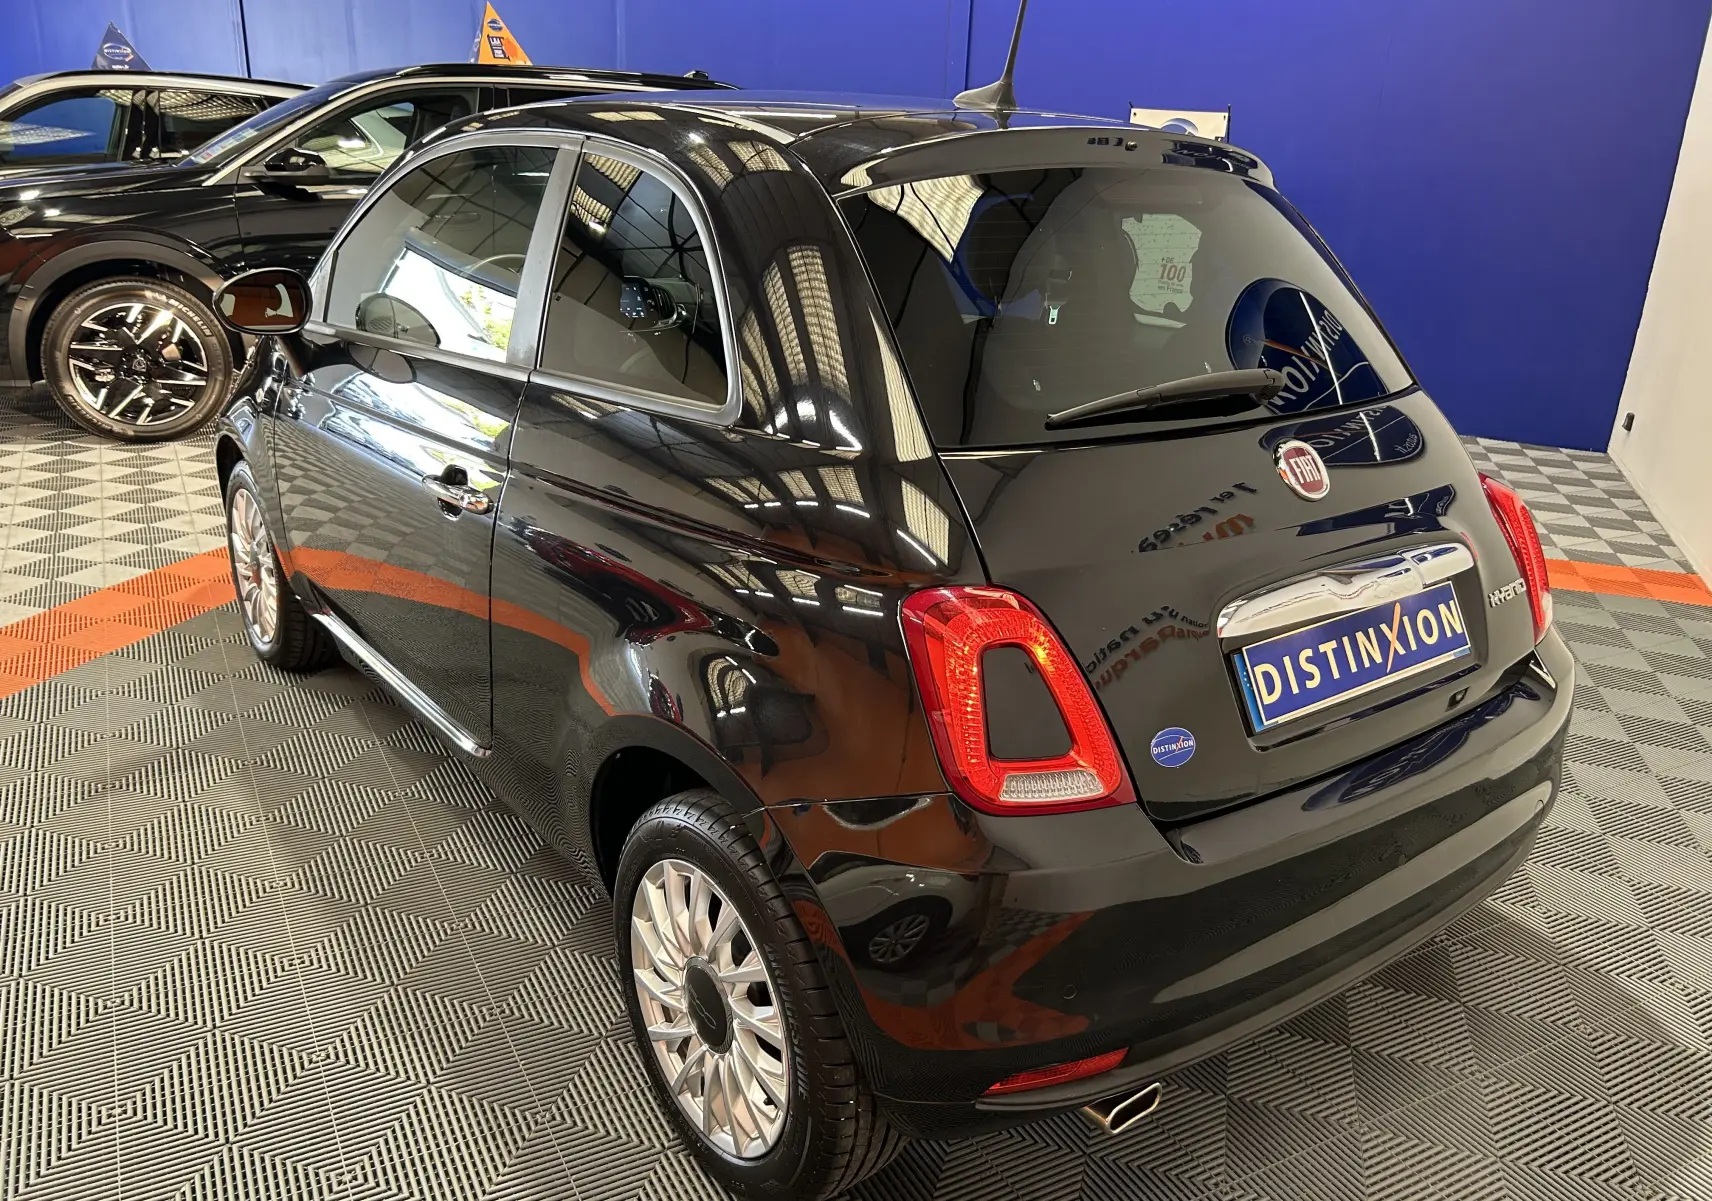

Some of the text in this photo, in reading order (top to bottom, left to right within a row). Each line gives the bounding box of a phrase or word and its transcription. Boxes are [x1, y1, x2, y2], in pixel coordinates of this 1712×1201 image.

[1160, 264, 1187, 283] 100
[168, 299, 212, 336] MICHELIN
[1288, 455, 1321, 484] FIAT
[1253, 600, 1464, 705] DISTINXION
[1152, 736, 1194, 755] DISTINXION
